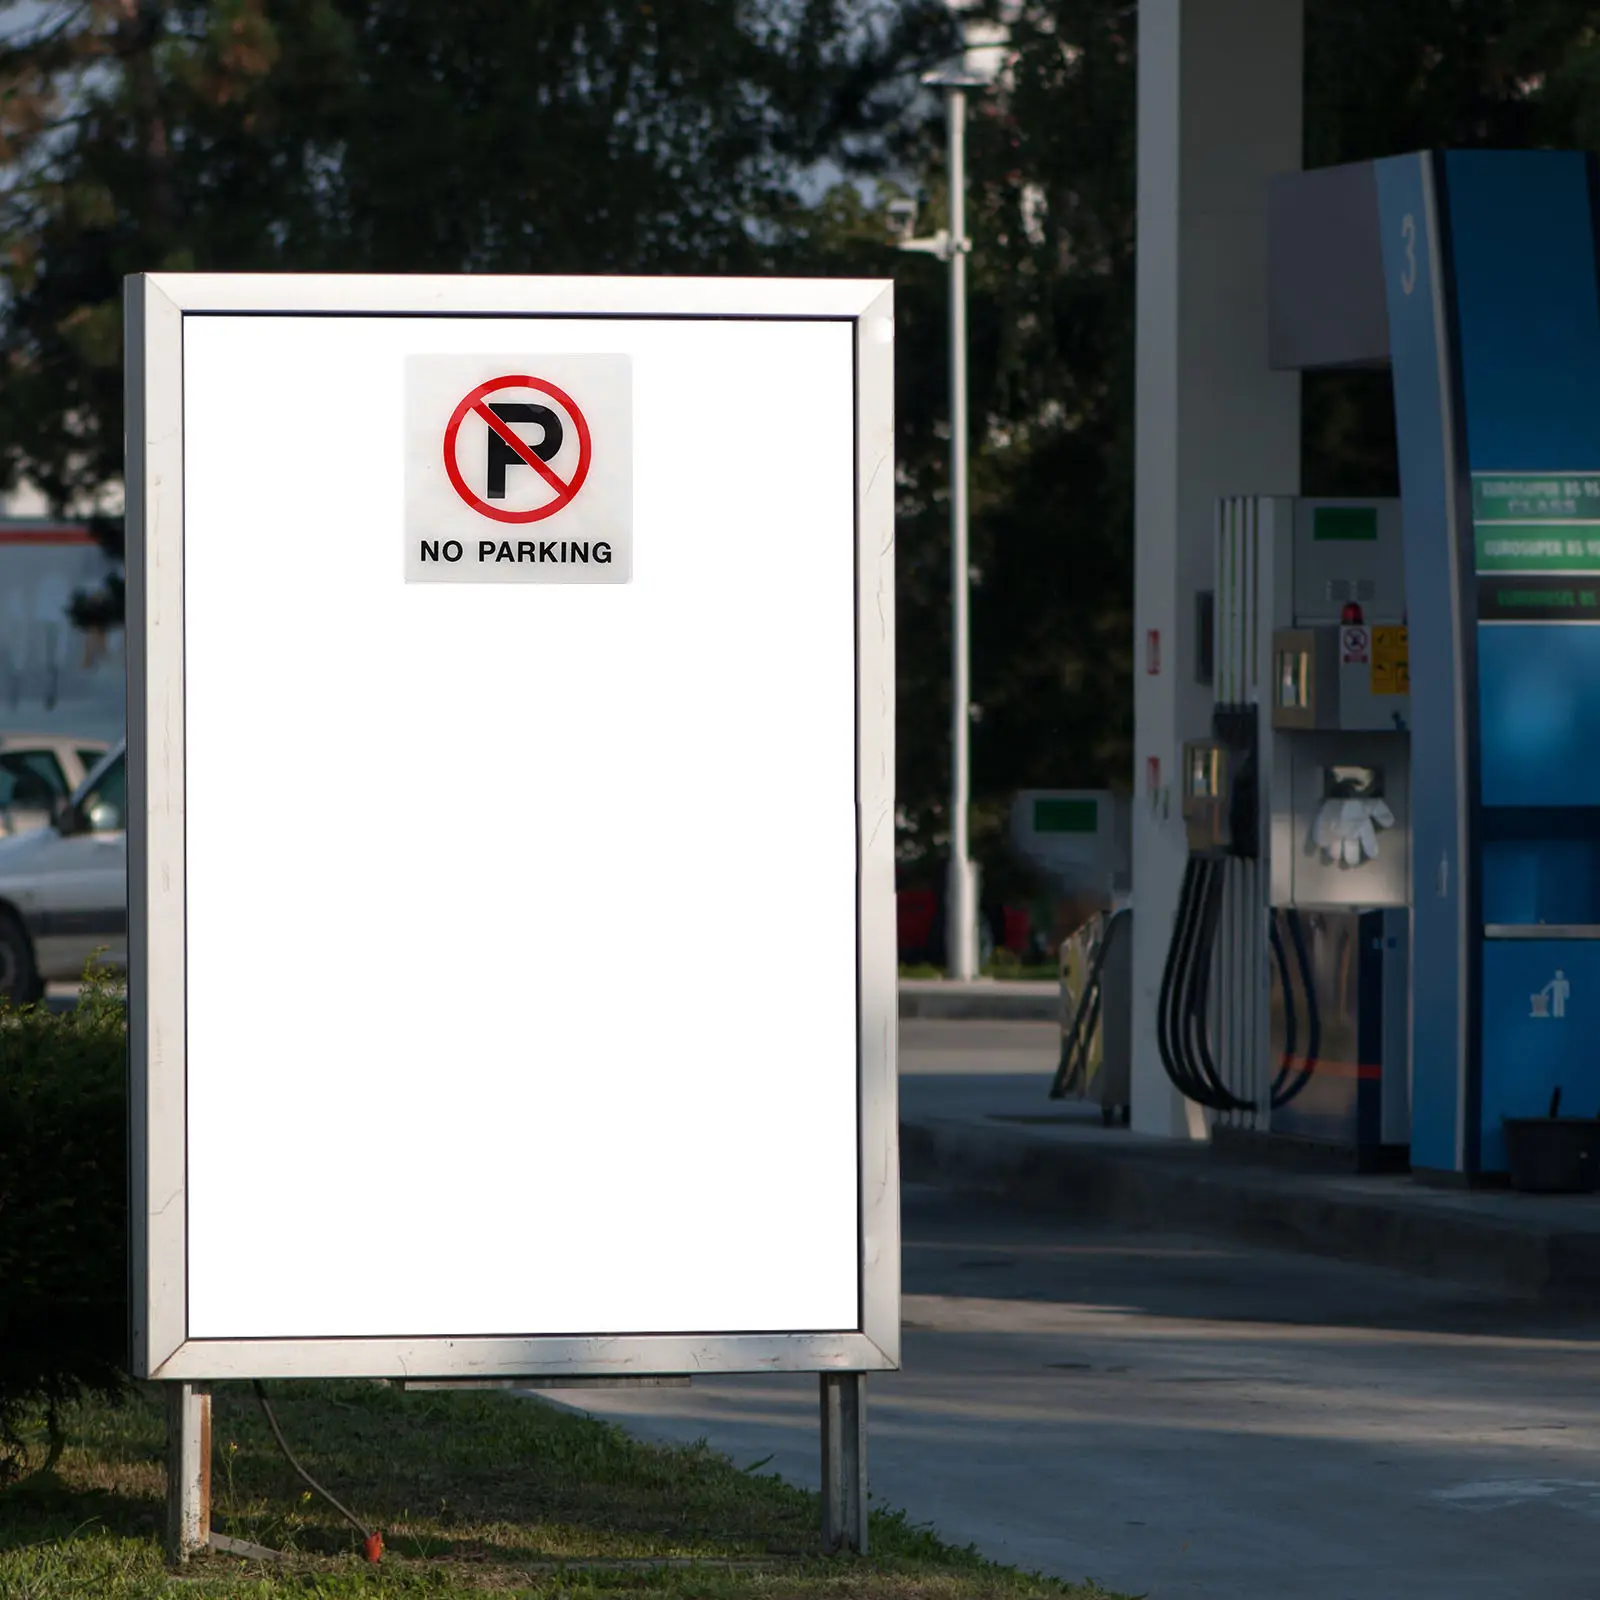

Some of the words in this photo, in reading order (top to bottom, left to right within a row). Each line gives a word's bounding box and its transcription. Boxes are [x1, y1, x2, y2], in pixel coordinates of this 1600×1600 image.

[1400, 212, 1417, 296] 3
[487, 402, 563, 499] P
[420, 540, 463, 562] NO
[478, 541, 612, 563] PARKING
